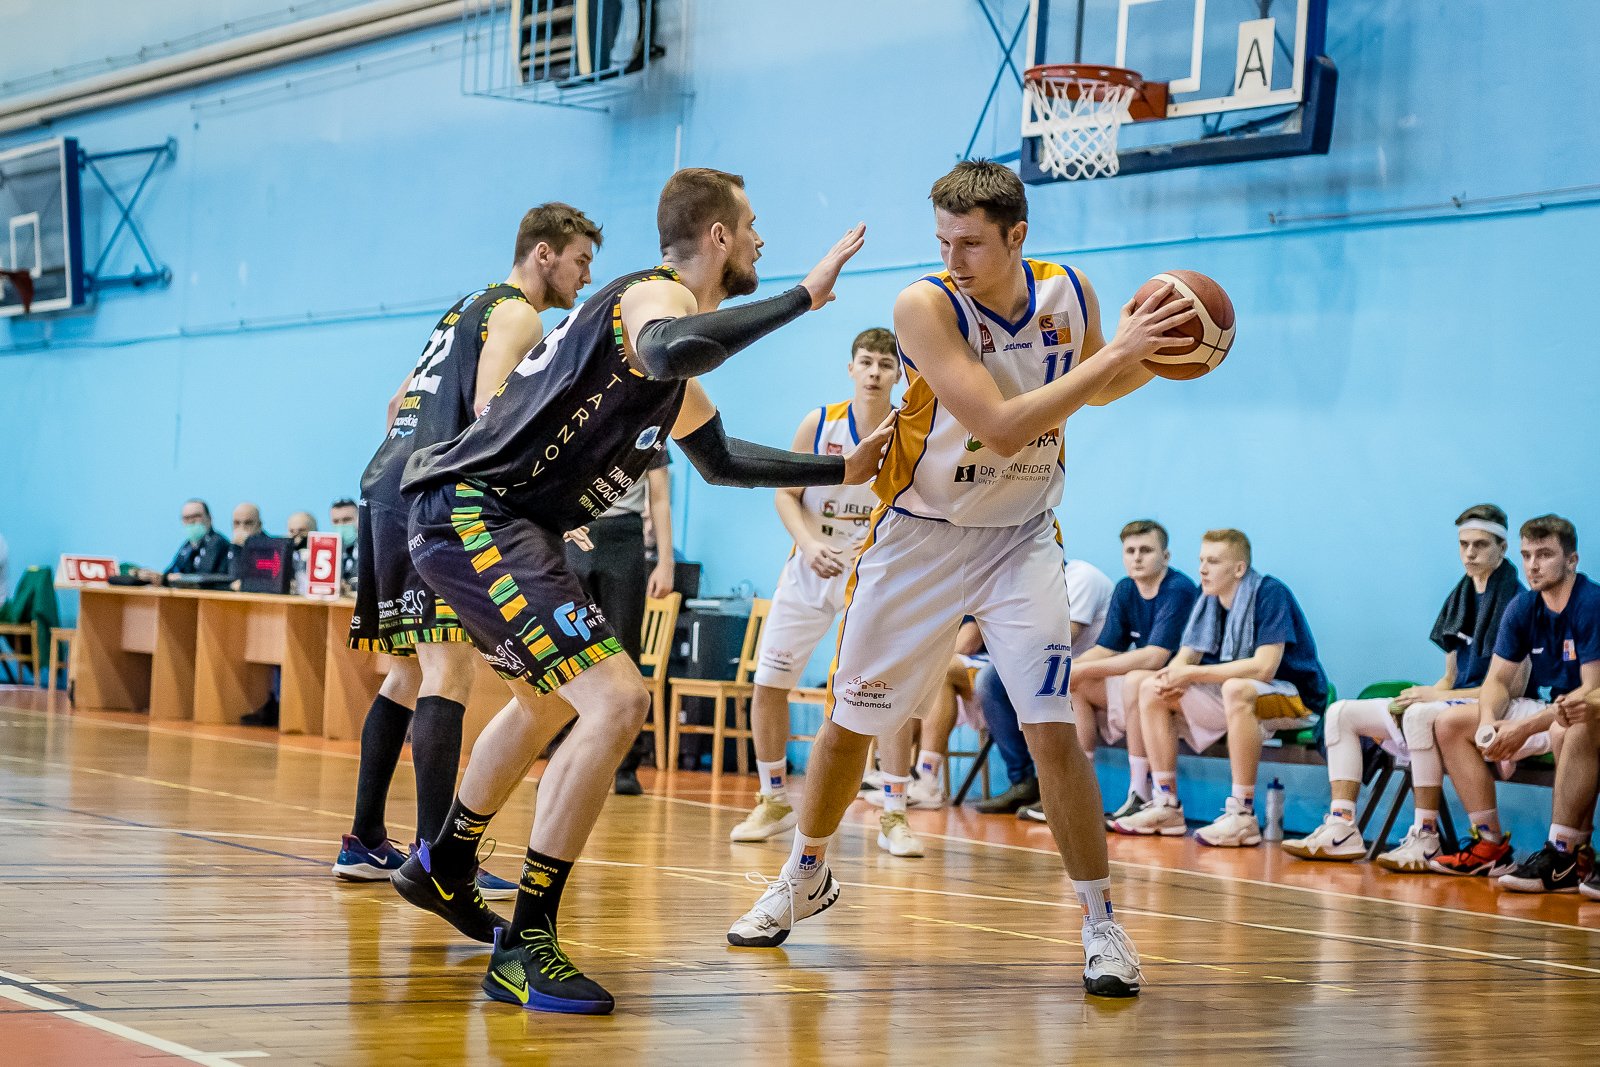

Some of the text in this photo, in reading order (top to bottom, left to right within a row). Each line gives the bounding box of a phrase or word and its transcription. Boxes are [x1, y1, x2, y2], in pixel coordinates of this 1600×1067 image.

[1238, 38, 1268, 89] A
[1042, 348, 1075, 387] 11
[491, 372, 623, 498] TARNOVIA
[1025, 430, 1058, 449] RA
[979, 465, 998, 478] DR.
[313, 549, 333, 580] 5
[1035, 654, 1072, 698] 11
